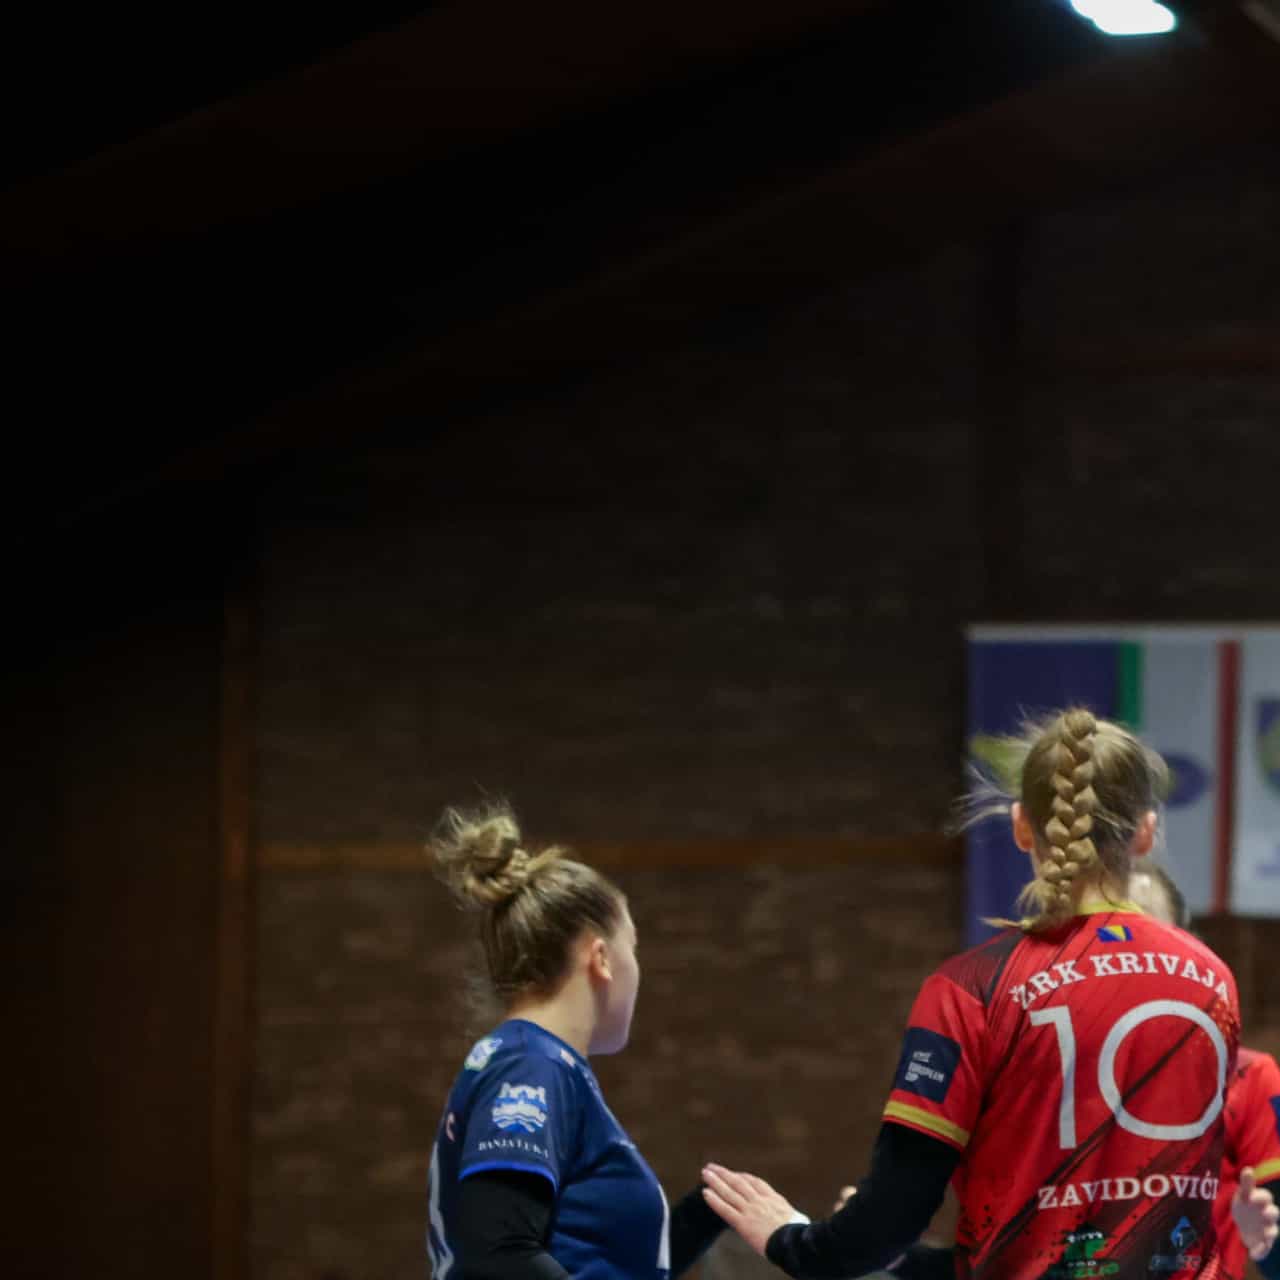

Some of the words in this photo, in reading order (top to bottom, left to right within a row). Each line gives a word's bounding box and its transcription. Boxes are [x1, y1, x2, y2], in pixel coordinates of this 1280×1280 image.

[1008, 959, 1086, 1010] ŽRK
[1089, 951, 1231, 1003] KRIVAJA
[1030, 999, 1228, 1150] 10
[1038, 1170, 1219, 1210] ZAVIDOVIĆI
